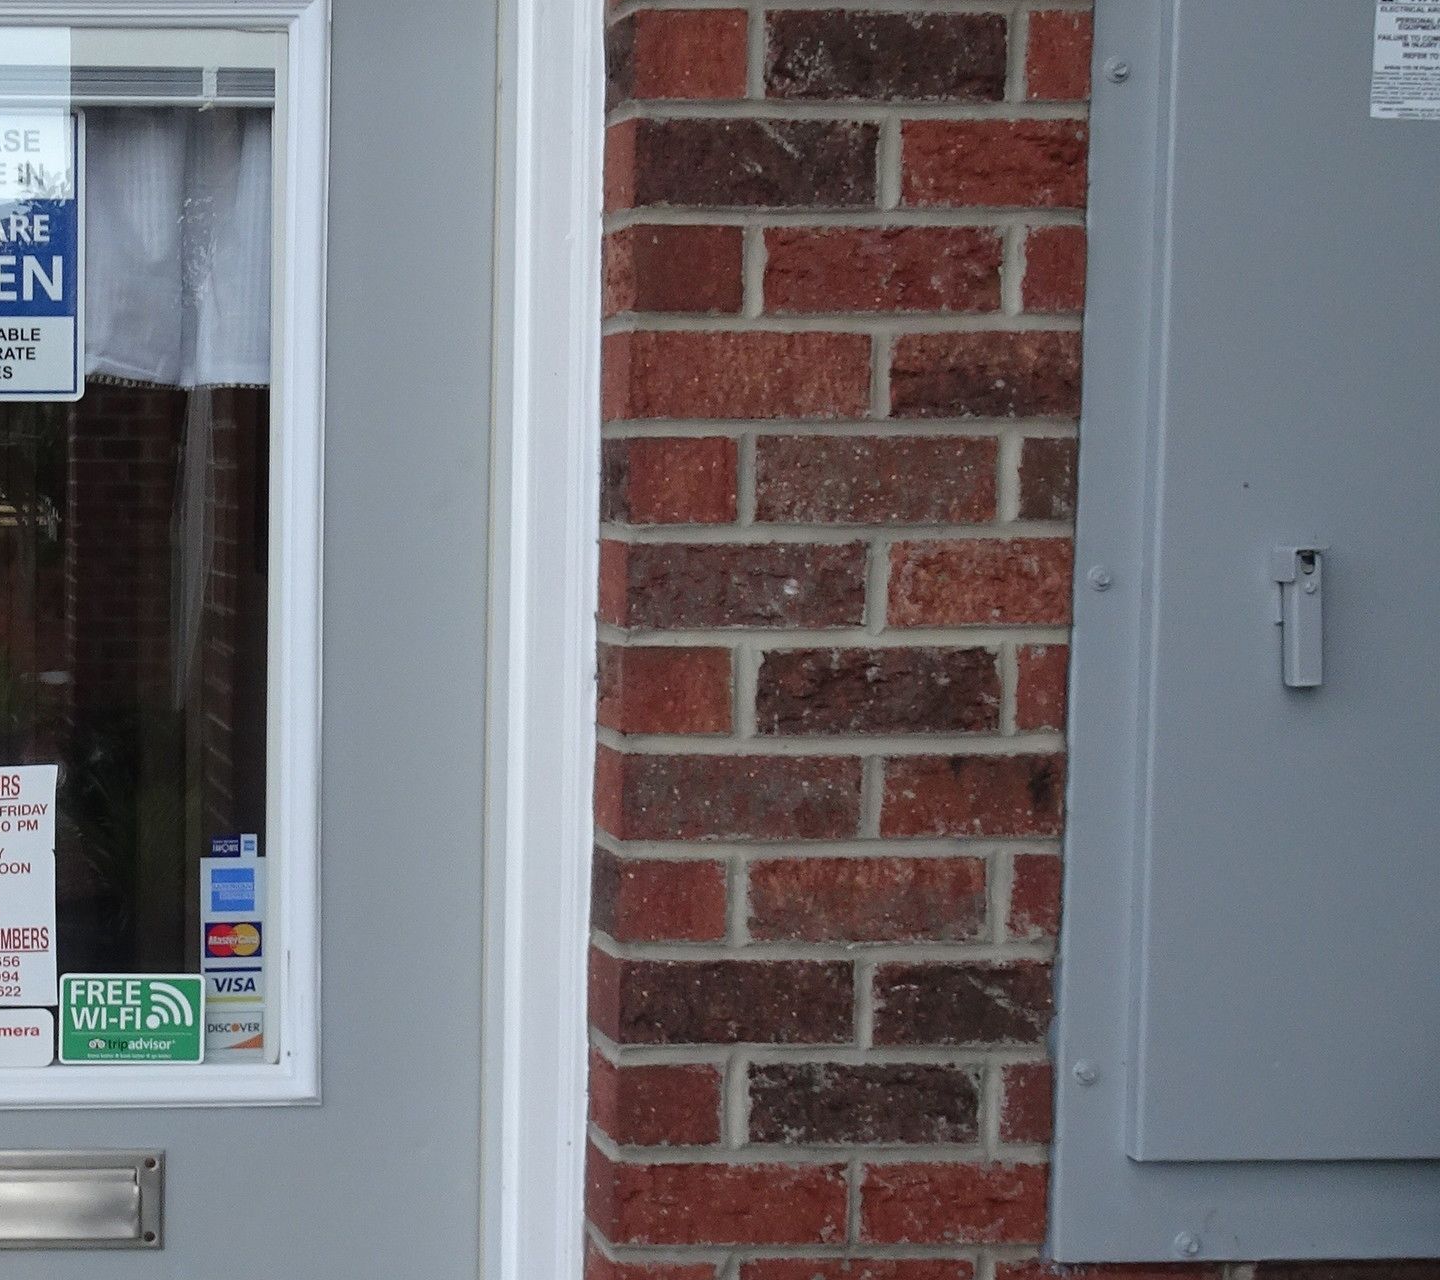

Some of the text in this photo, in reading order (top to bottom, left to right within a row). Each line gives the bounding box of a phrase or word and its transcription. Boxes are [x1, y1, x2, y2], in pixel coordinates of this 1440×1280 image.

[18, 162, 44, 186] IN
[0, 804, 48, 817] FRIDAY
[17, 820, 39, 832] PM
[213, 977, 256, 992] VISA
[70, 980, 141, 1005] FREE
[70, 1007, 141, 1030] WI-FI
[207, 1022, 260, 1033] DISCOVER
[108, 1037, 172, 1052] tripadvisor
